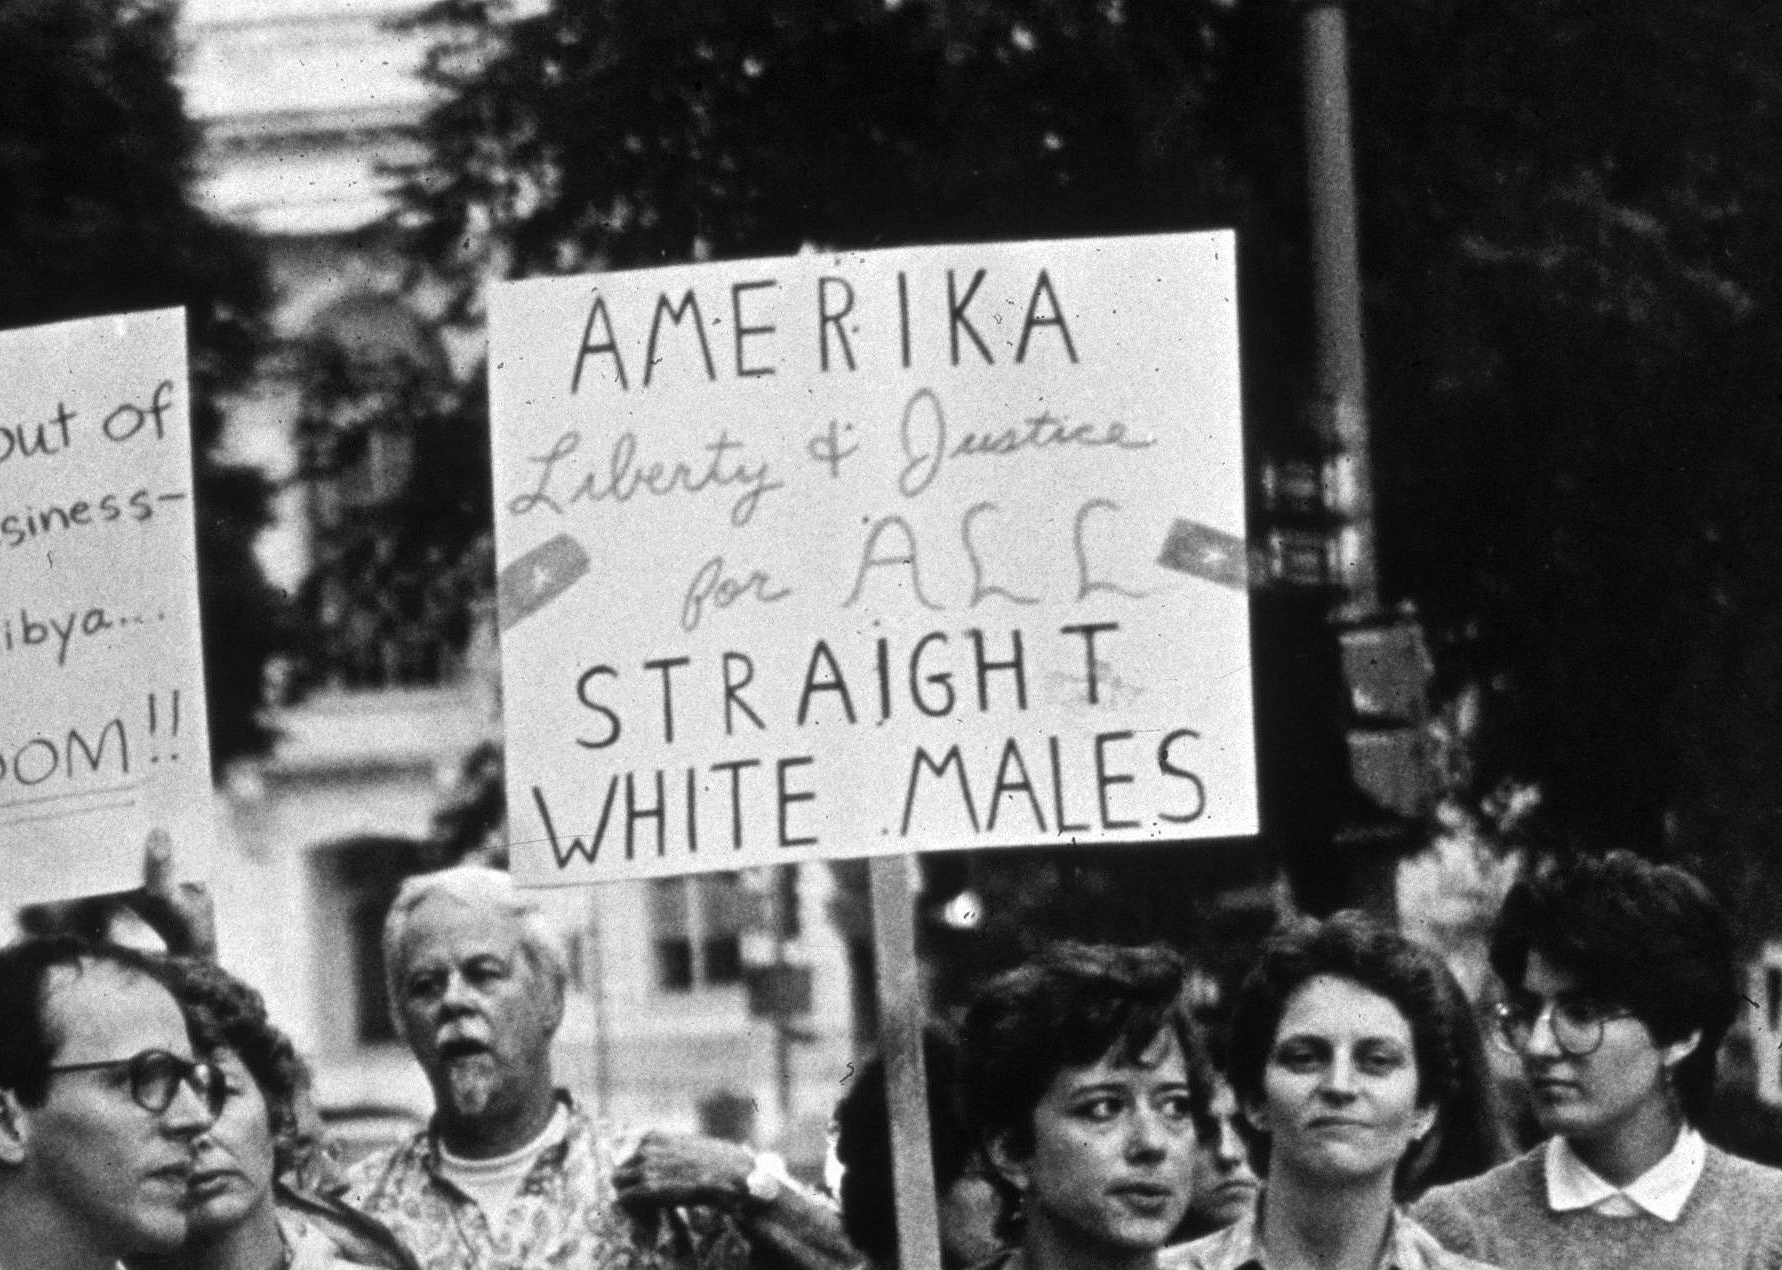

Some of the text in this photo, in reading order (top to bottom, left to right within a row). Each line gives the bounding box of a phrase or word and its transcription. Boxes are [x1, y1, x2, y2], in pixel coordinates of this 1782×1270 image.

[571, 268, 1080, 394] AMERIKA
[102, 380, 173, 441] of
[509, 430, 784, 526] Liberty
[898, 387, 1157, 497] Justice
[681, 497, 1152, 632] for ALL
[575, 622, 1119, 748] STRAIGHT
[532, 728, 1206, 868] WHITE MALES
